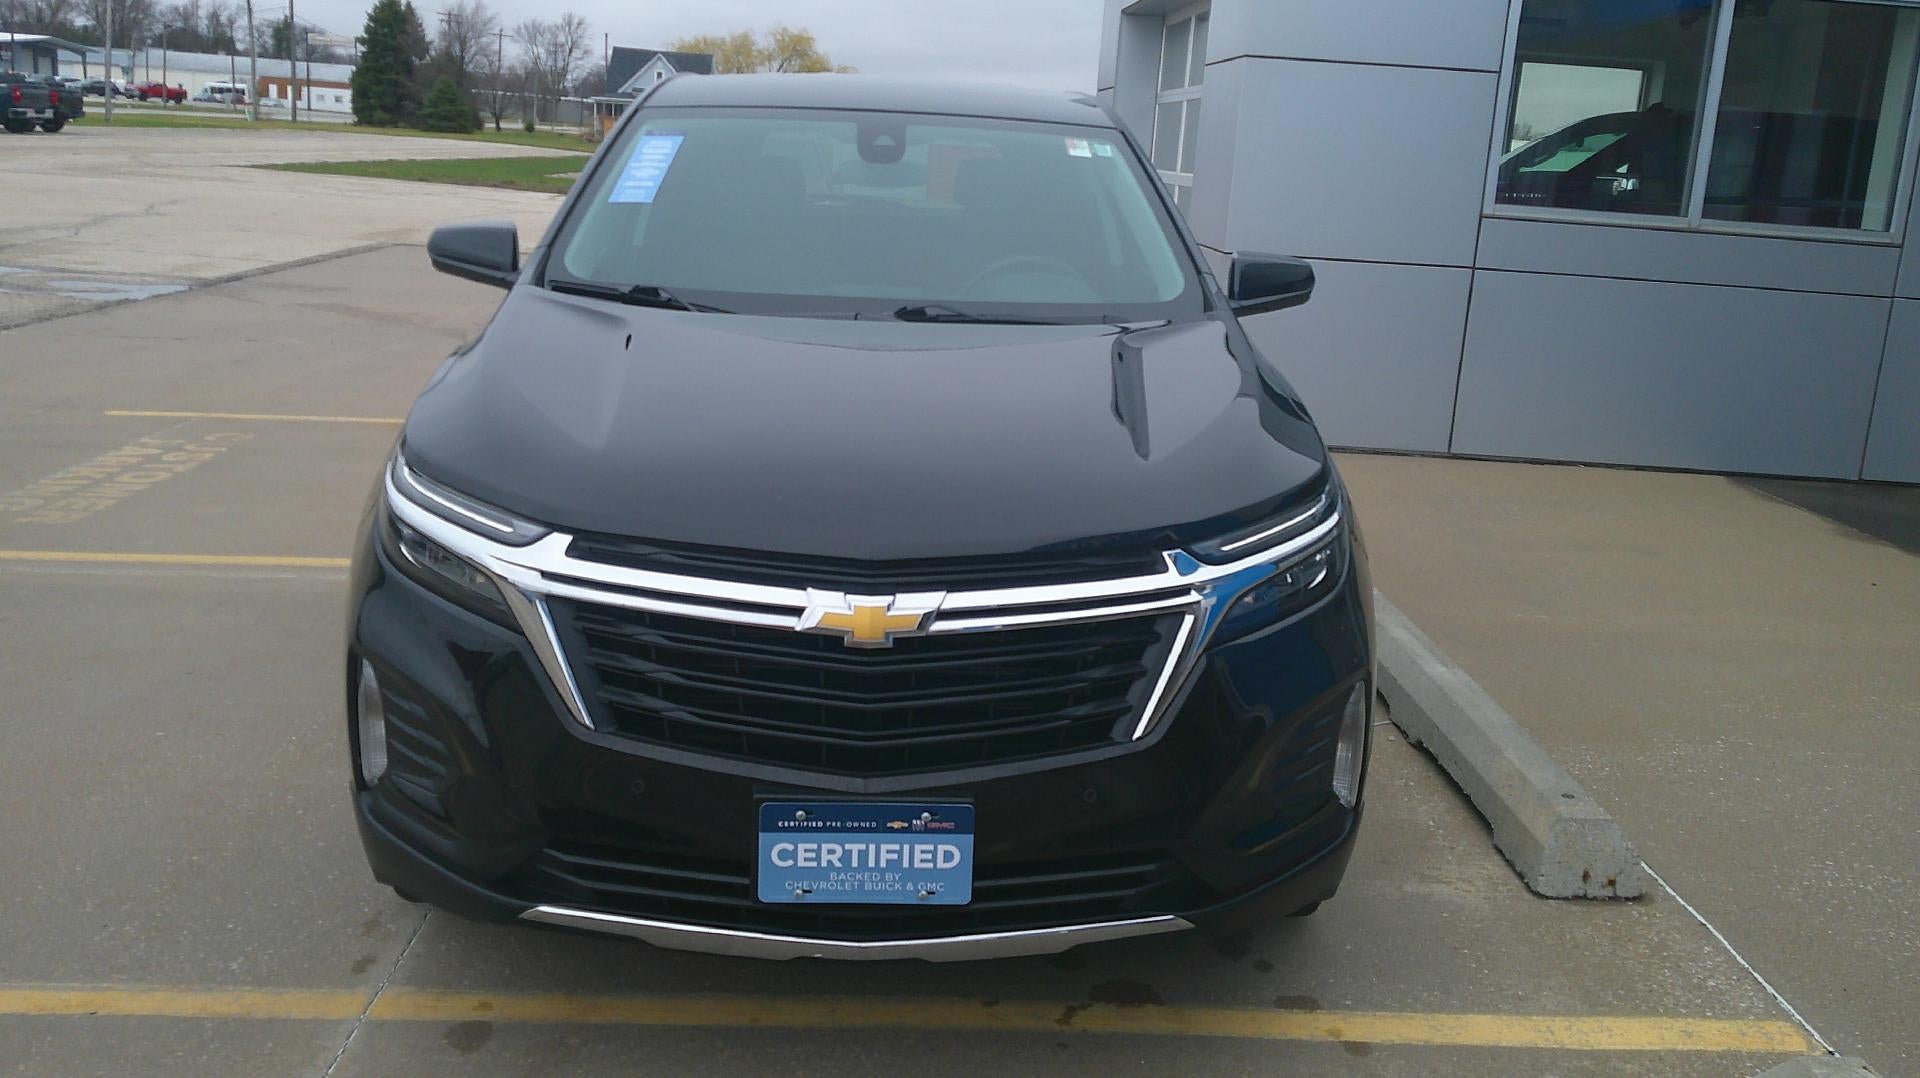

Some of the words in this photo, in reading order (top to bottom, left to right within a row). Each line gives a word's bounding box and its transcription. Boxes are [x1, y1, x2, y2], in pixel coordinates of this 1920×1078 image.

[778, 820, 824, 829] CERTIFIED
[769, 842, 962, 870] CERTIFIED
[829, 871, 881, 882] BACKED
[885, 872, 903, 882] BY
[784, 880, 860, 891] CHEVROLET
[864, 881, 903, 891] BUICK
[905, 882, 914, 891] &
[918, 882, 945, 892] GMC
